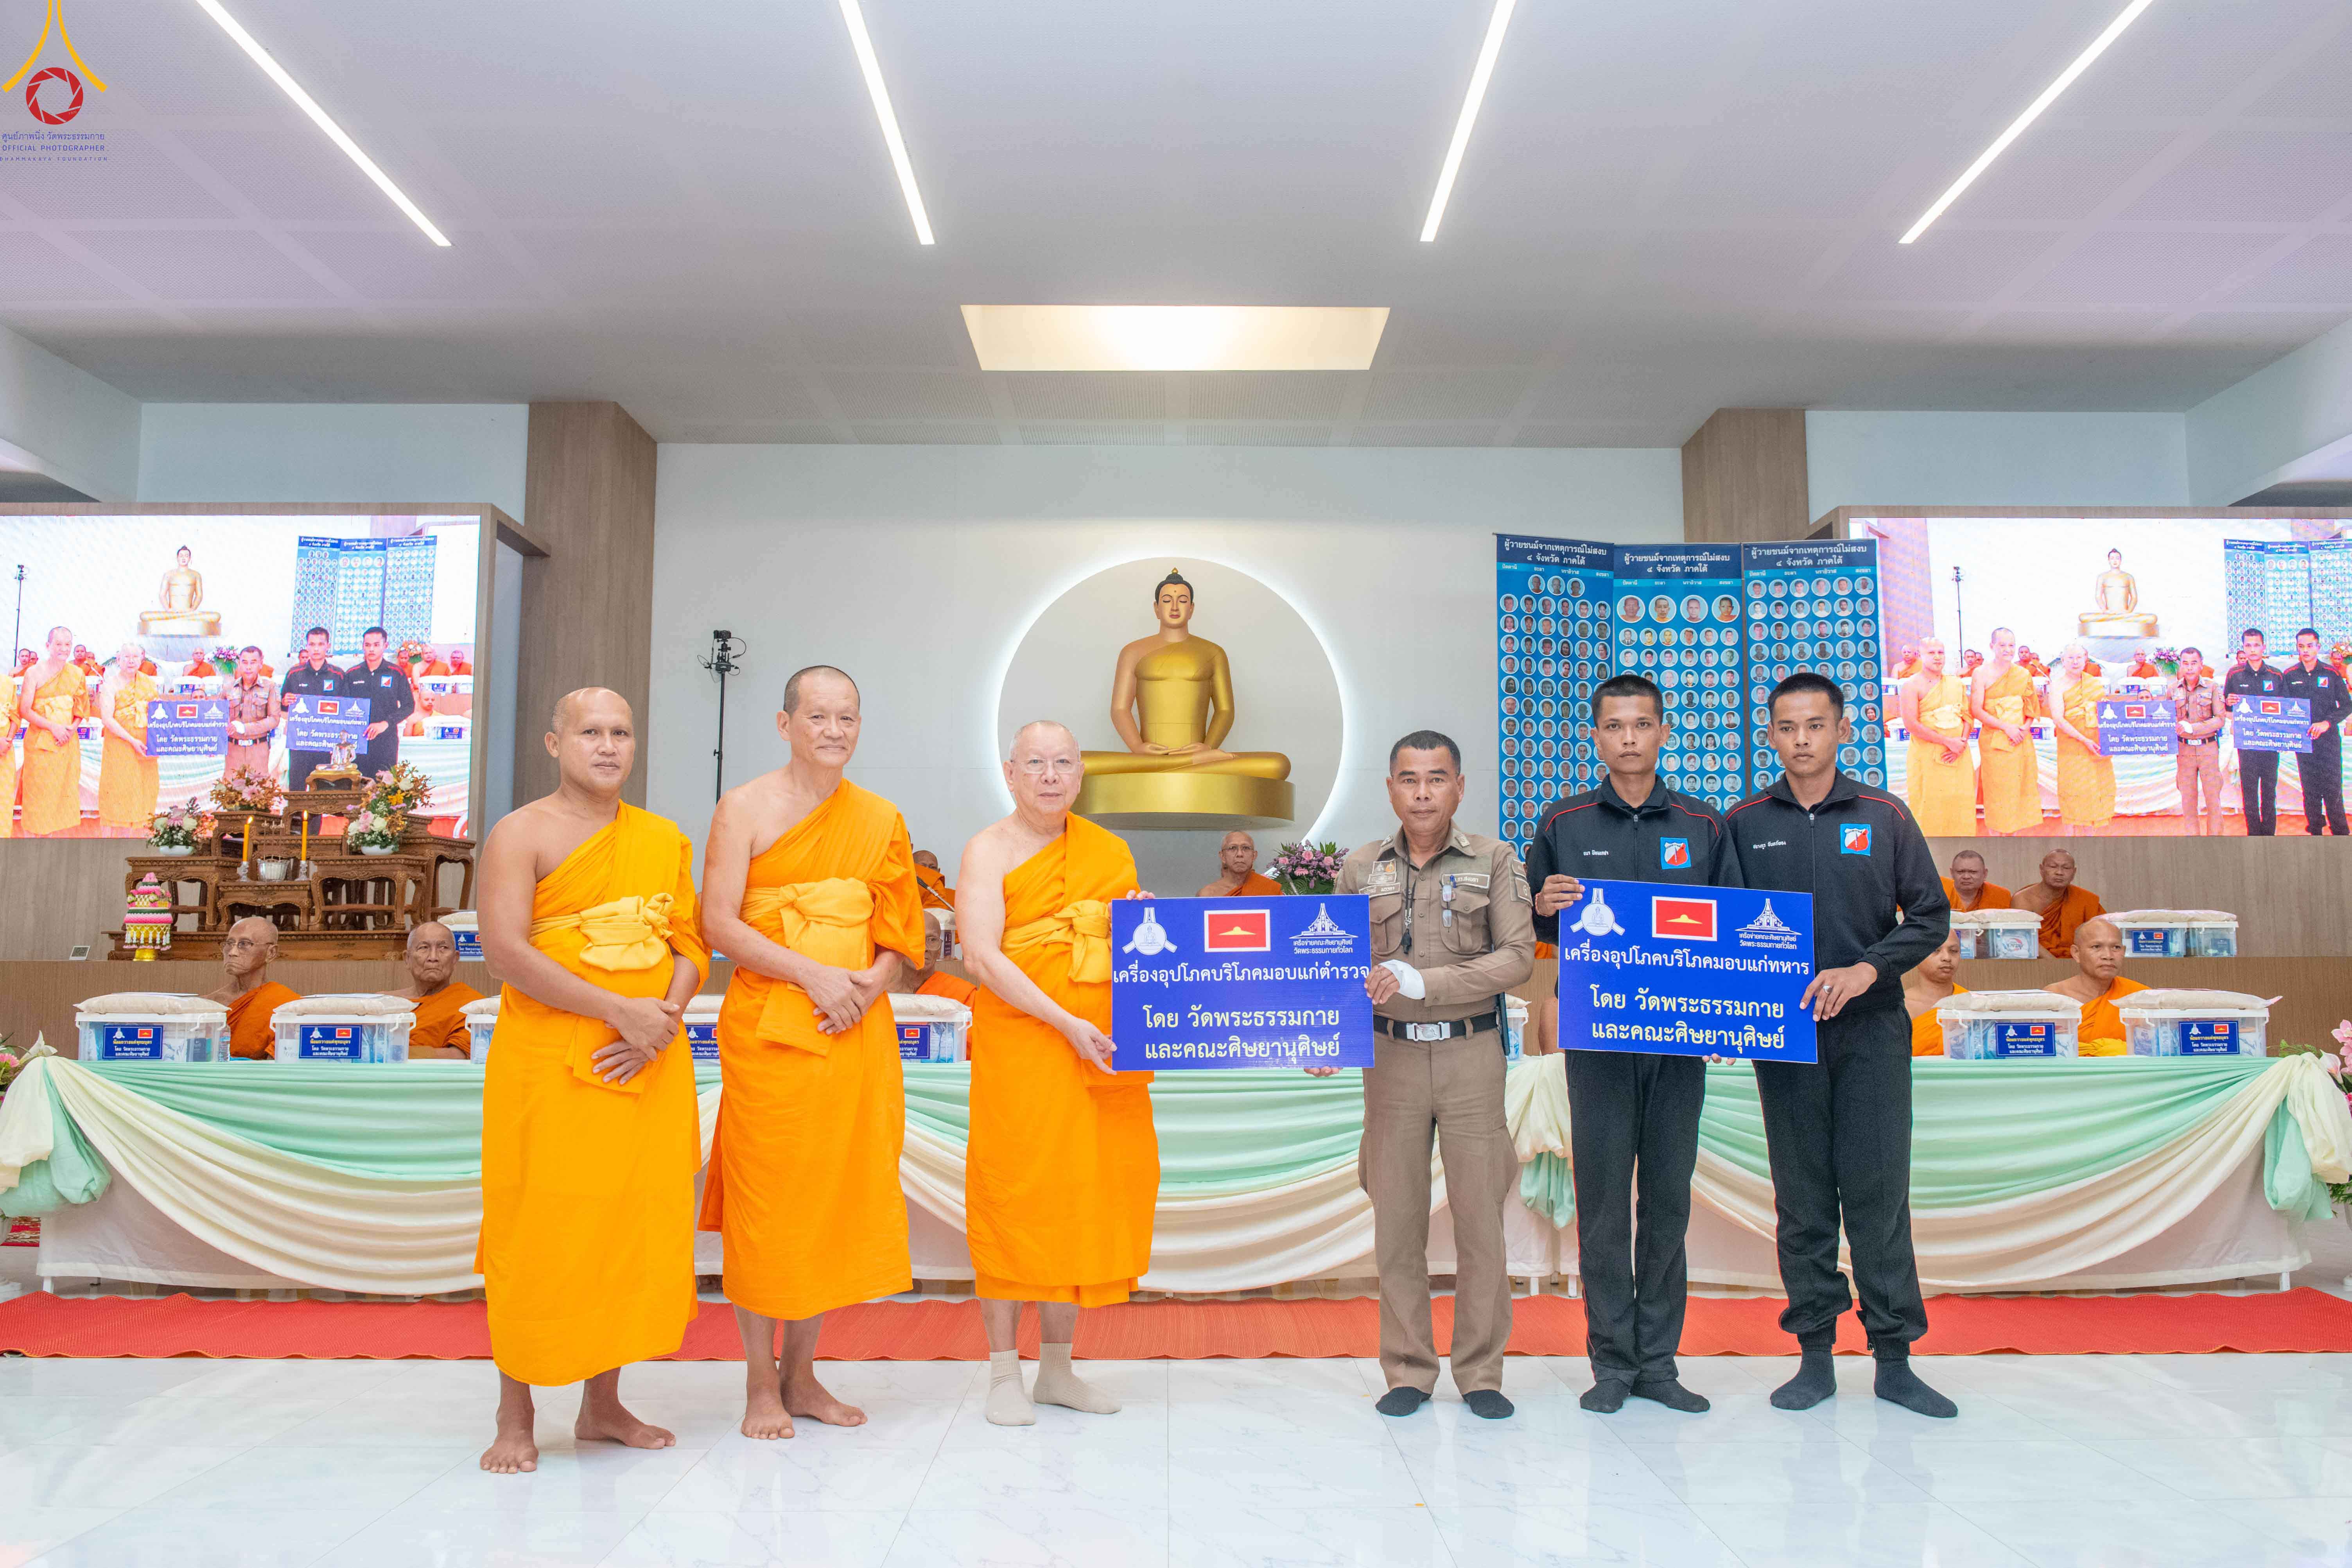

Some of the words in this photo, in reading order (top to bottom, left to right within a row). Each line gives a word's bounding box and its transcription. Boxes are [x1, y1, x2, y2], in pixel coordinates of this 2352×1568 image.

[1536, 553, 1559, 562] จังหวัด
[1563, 556, 1586, 565] ภาคใต้
[1786, 557, 1813, 566] จังหวัด
[1817, 555, 1843, 565] ภาคใต้
[1684, 563, 1708, 572] ภาคใต้
[1293, 938, 1353, 947] เครือข่ายคณะศิษยานุศิษย์
[1739, 932, 1796, 942] เครือข่ายคณะศิษยานุศิษย์
[1294, 946, 1353, 954] วัดพระธรรมกายทั่วโลก
[1740, 940, 1797, 950] วัดพระธรรมกายทั่วโลก
[1565, 939, 1809, 975] เครื่องอุปโภคบริโภคมอบแก่ทหาร
[1113, 960, 1369, 989] เครื่องอุปโภคบริโภคมอบแก่ตำรวจ
[1590, 984, 1626, 1009] โดย
[1634, 987, 1784, 1018] วัดพระธรรมกาย
[1143, 1005, 1179, 1028] โดย
[1188, 1005, 1339, 1027] วัดพระธรรมกาย
[1592, 1021, 1785, 1053] และคณะศิษยานุศิษย์
[1145, 1032, 1340, 1064] และคณะศิษยานุศิษย์
